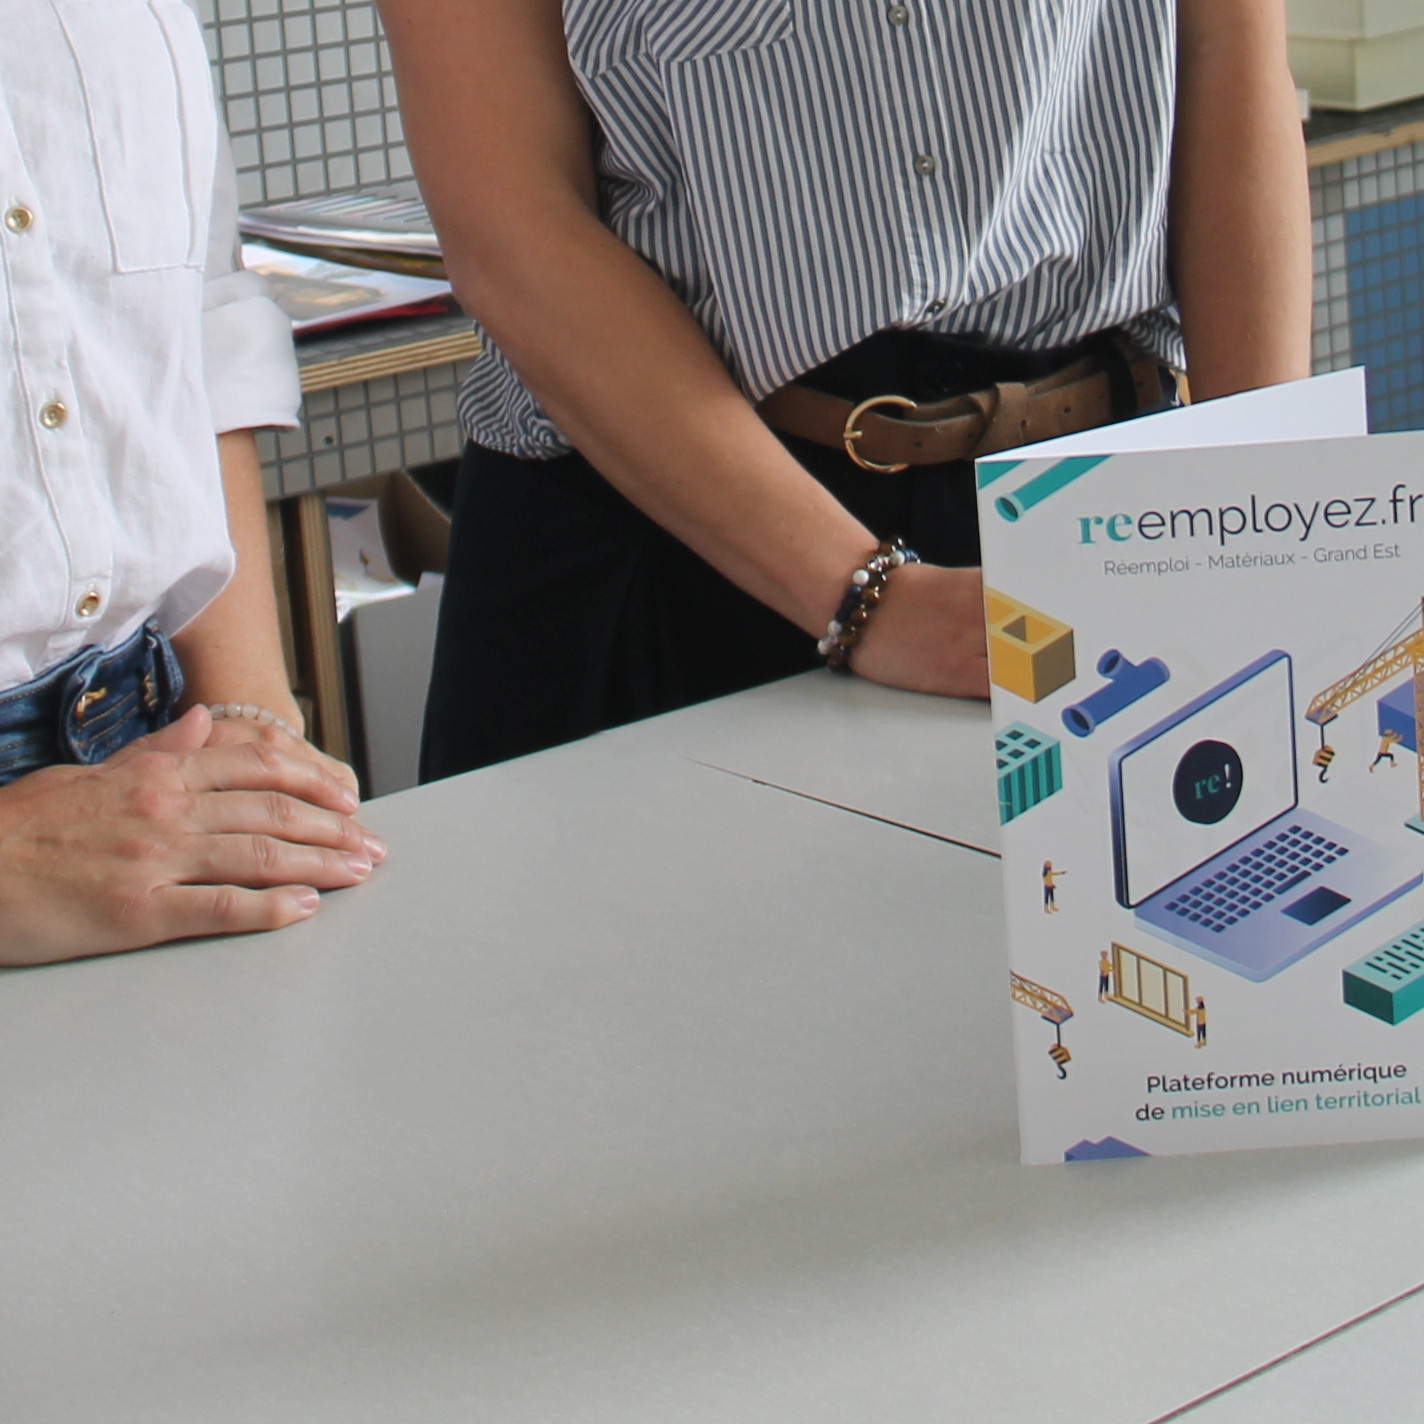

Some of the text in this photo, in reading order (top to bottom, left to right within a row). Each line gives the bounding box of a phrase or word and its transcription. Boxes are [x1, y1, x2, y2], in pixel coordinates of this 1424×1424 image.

[1077, 484, 1424, 545] reemployez.fr
[1104, 557, 1190, 577] Réemploi
[1208, 550, 1295, 570] Matériaux
[1313, 545, 1368, 564] Grand
[1373, 544, 1401, 560] Est
[1147, 1062, 1407, 1094] Plateforme numérique
[1135, 1087, 1422, 1121] de mise en lien territorial
